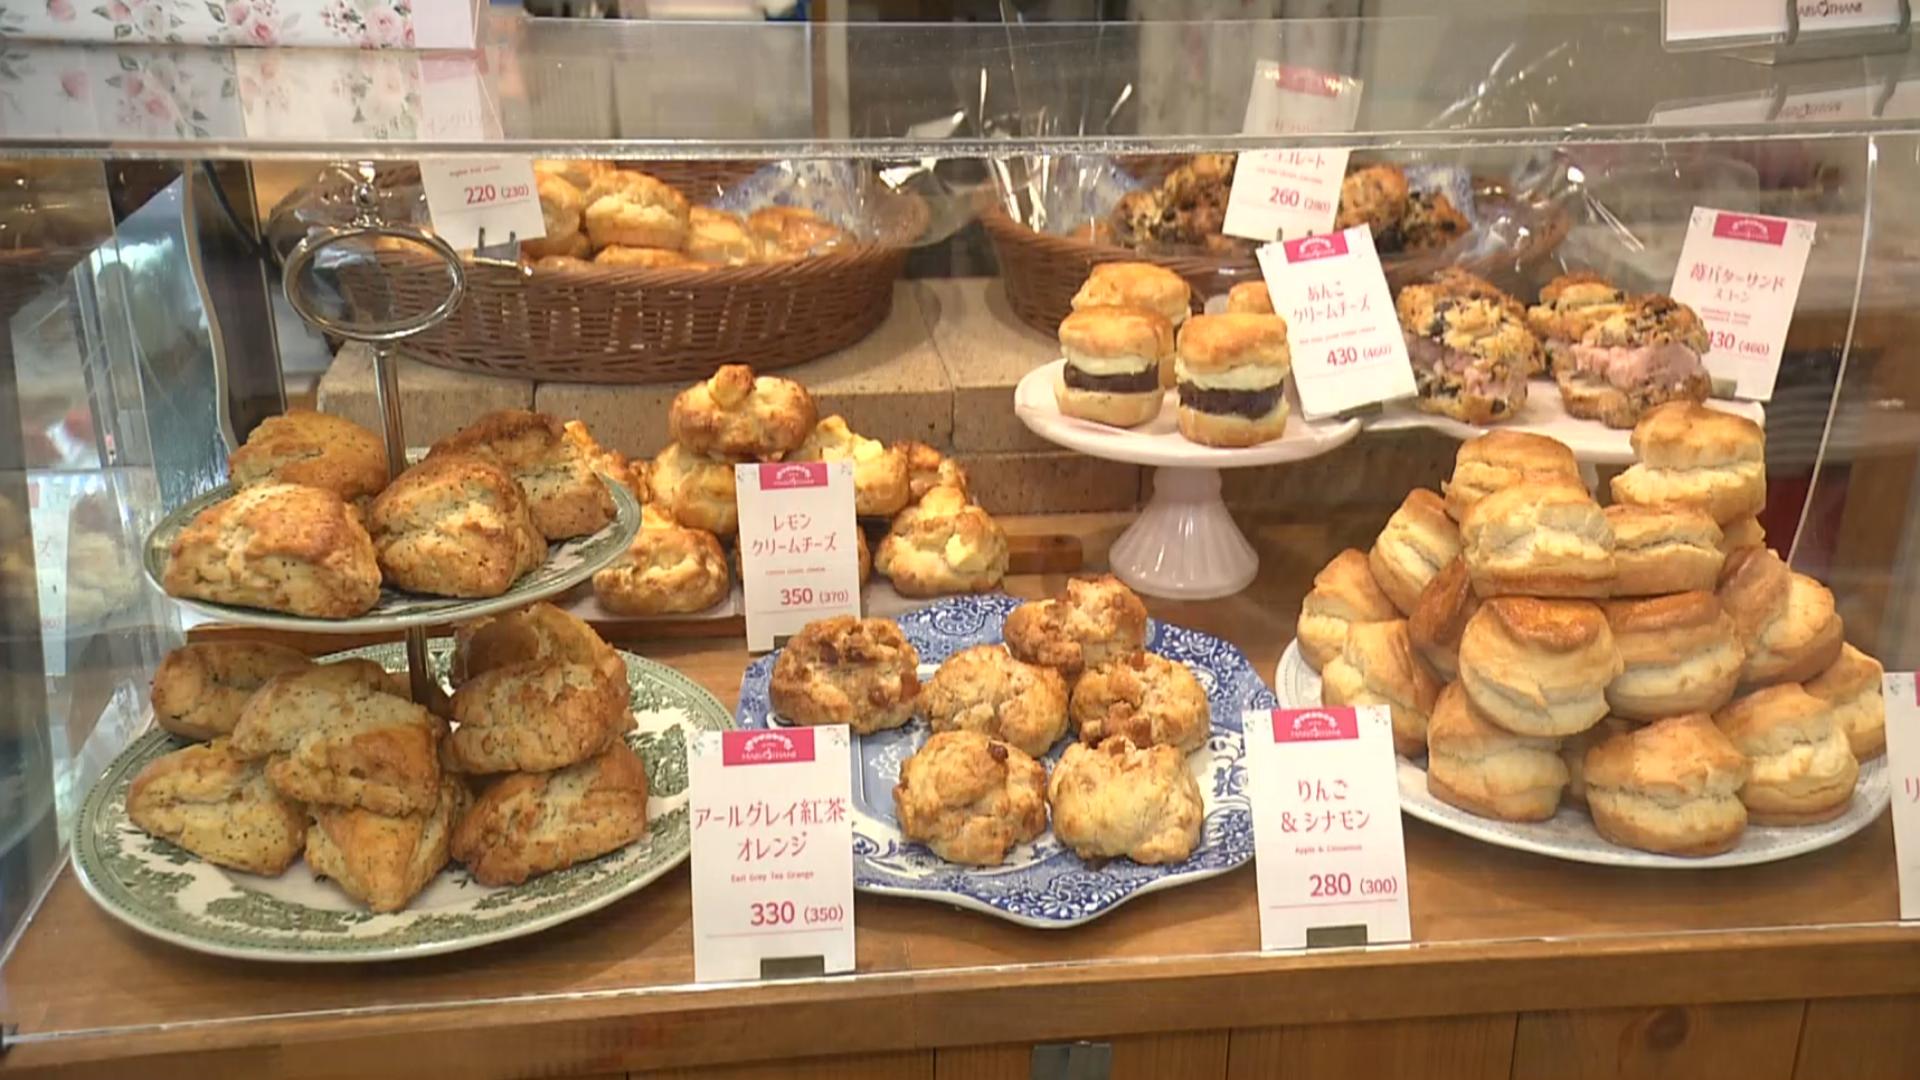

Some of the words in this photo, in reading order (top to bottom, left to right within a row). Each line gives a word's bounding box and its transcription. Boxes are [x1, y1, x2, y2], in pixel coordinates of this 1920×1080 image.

[465, 184, 496, 205] 220
[1269, 186, 1300, 207] 260
[1307, 280, 1345, 302] あんこ
[1293, 293, 1371, 324] クリームチーズ
[1326, 346, 1358, 367] 430
[773, 513, 812, 532] レモン
[752, 532, 838, 557] クリームチーズ
[780, 588, 814, 606] 350
[1297, 778, 1348, 802] りんご
[695, 797, 847, 831] アールグレイ紅茶
[1281, 811, 1298, 833] &
[1305, 809, 1371, 833] シナモン
[737, 830, 808, 862] オレンジ
[1309, 873, 1352, 898] 280
[1360, 875, 1398, 895] (300)
[750, 901, 796, 927] 330
[804, 903, 844, 925] (350)
